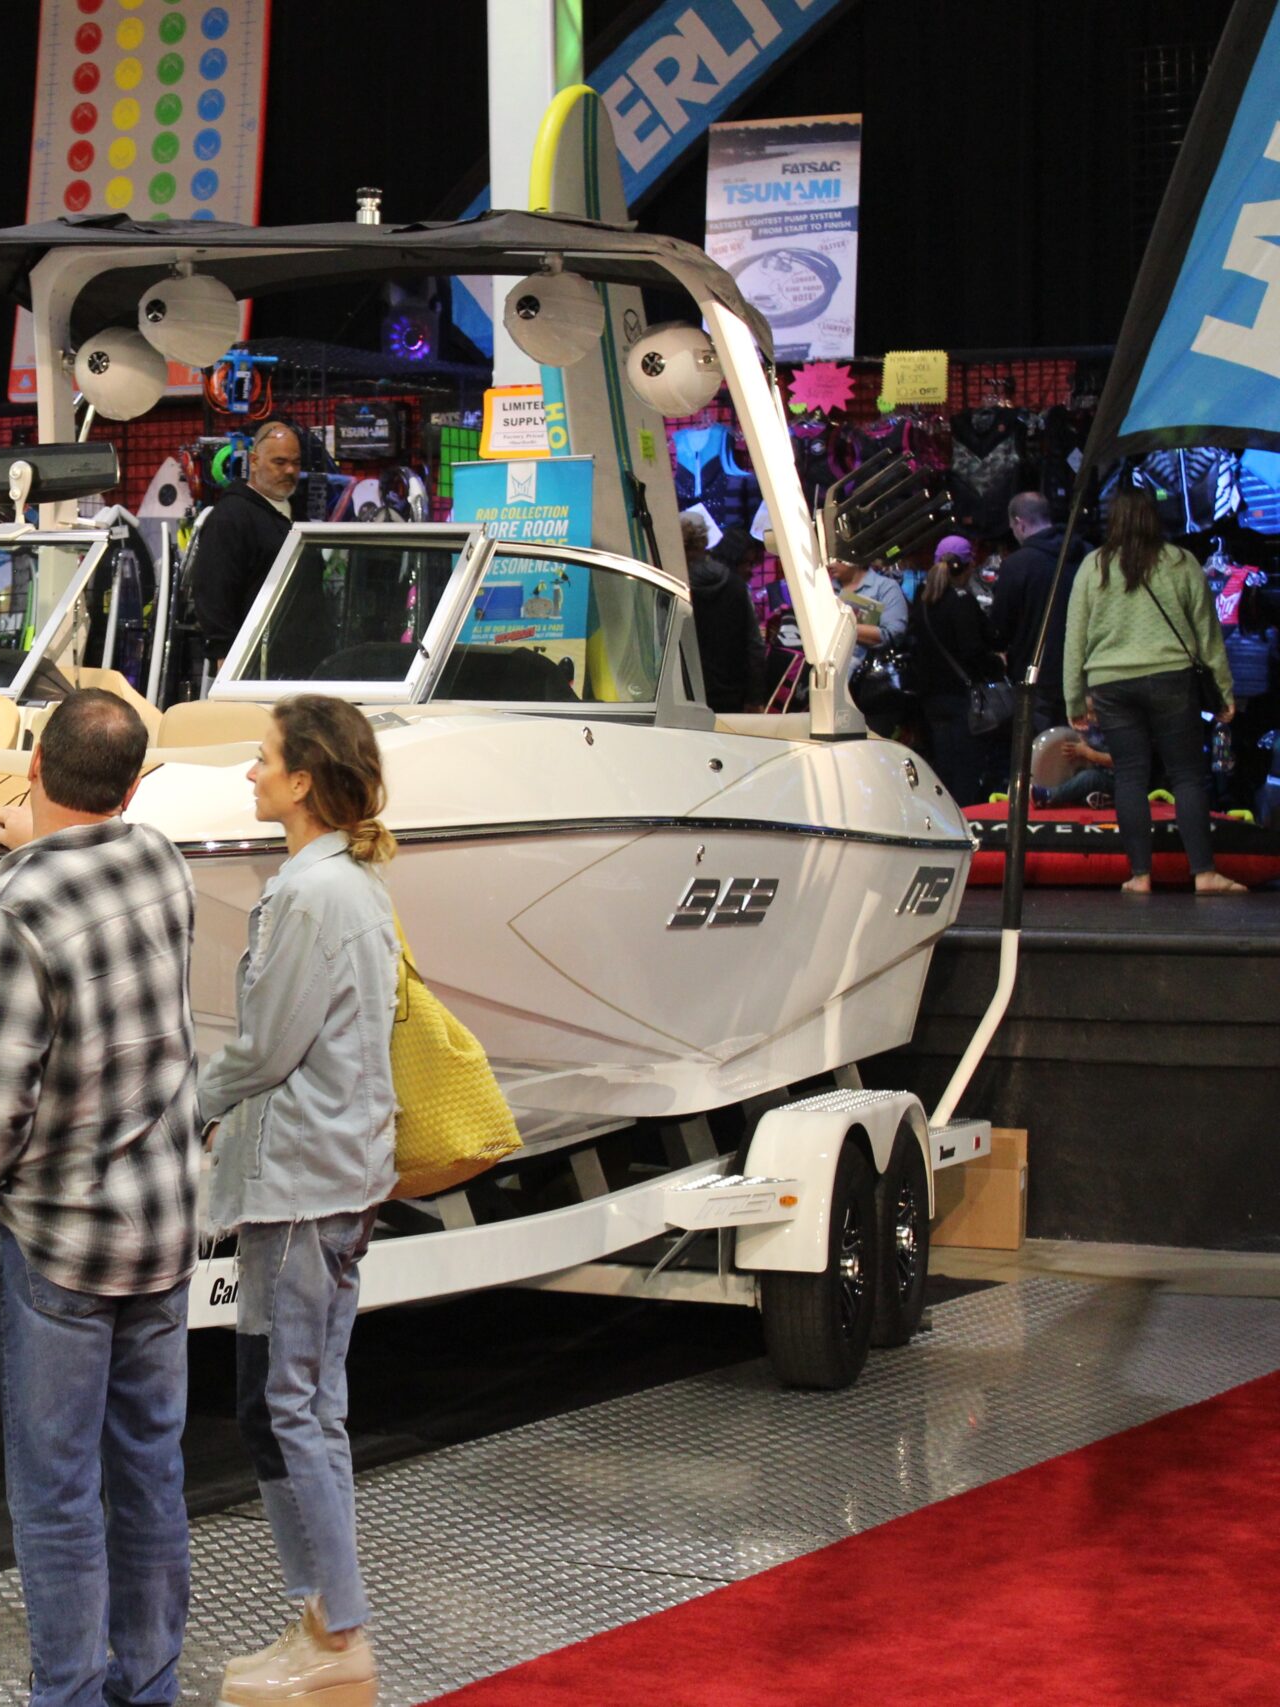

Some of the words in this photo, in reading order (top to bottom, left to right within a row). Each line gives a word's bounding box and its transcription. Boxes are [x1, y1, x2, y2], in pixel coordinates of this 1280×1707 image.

[600, 0, 821, 174] ERLI
[781, 161, 841, 175] FATSAC
[722, 178, 842, 205] TSUNAMI
[745, 217, 783, 227] LIGHTEST
[784, 214, 808, 223] PUMP
[810, 211, 842, 221] SYSTEM
[758, 226, 783, 236] FROM
[784, 224, 808, 234] START
[810, 223, 822, 232] TO
[823, 221, 852, 231] FINISH
[503, 417, 546, 427] SUPPLY
[476, 508, 498, 520] RAD
[501, 505, 569, 520] COLLECTION
[486, 521, 519, 538] ORE
[522, 519, 569, 537] ROOM
[487, 558, 567, 575] ESOMENESS
[209, 1277, 239, 1307] Cal
